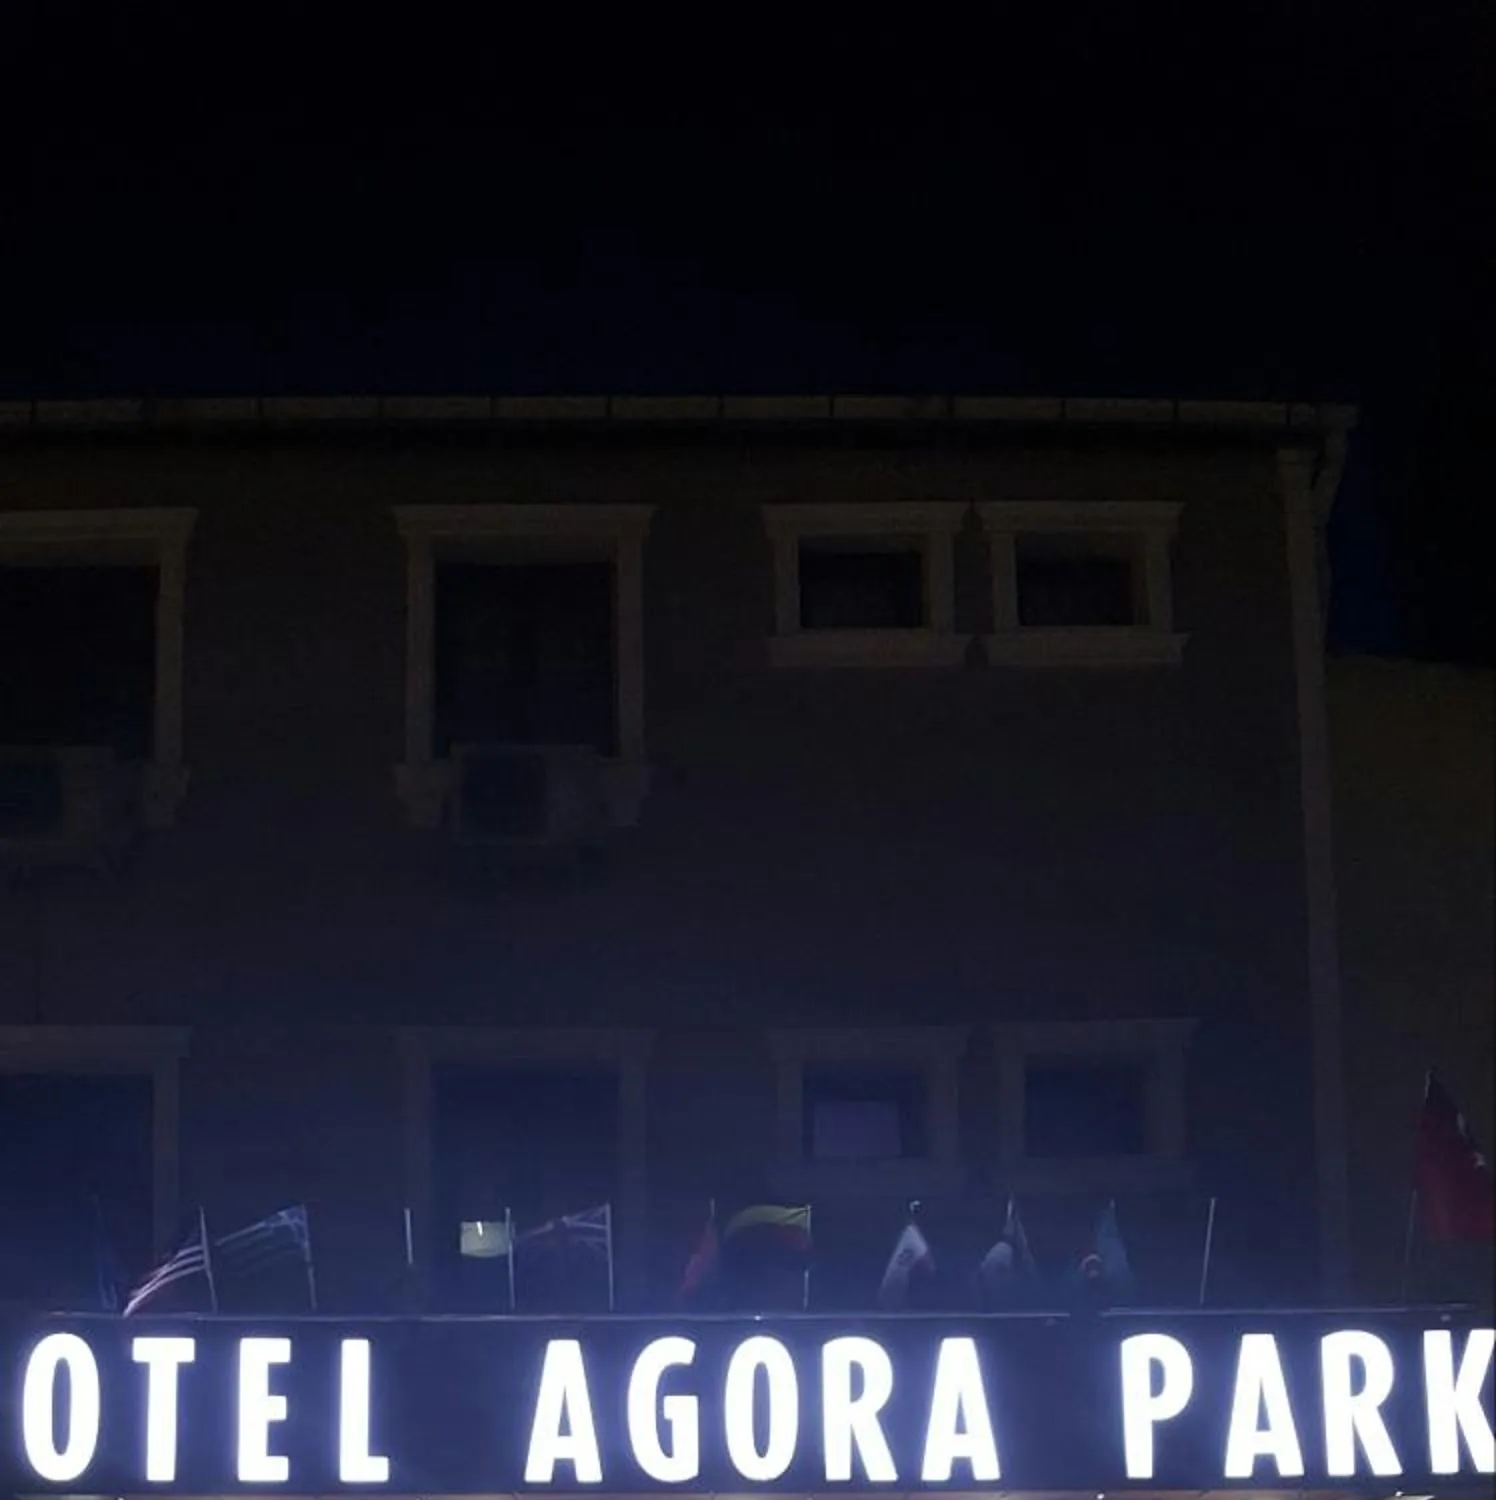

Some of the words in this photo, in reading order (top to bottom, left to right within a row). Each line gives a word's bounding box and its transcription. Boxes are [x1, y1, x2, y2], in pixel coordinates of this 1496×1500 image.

[23, 1332, 390, 1483] OTEL
[524, 1334, 1001, 1483] AGORA
[1120, 1327, 1496, 1479] PARK
